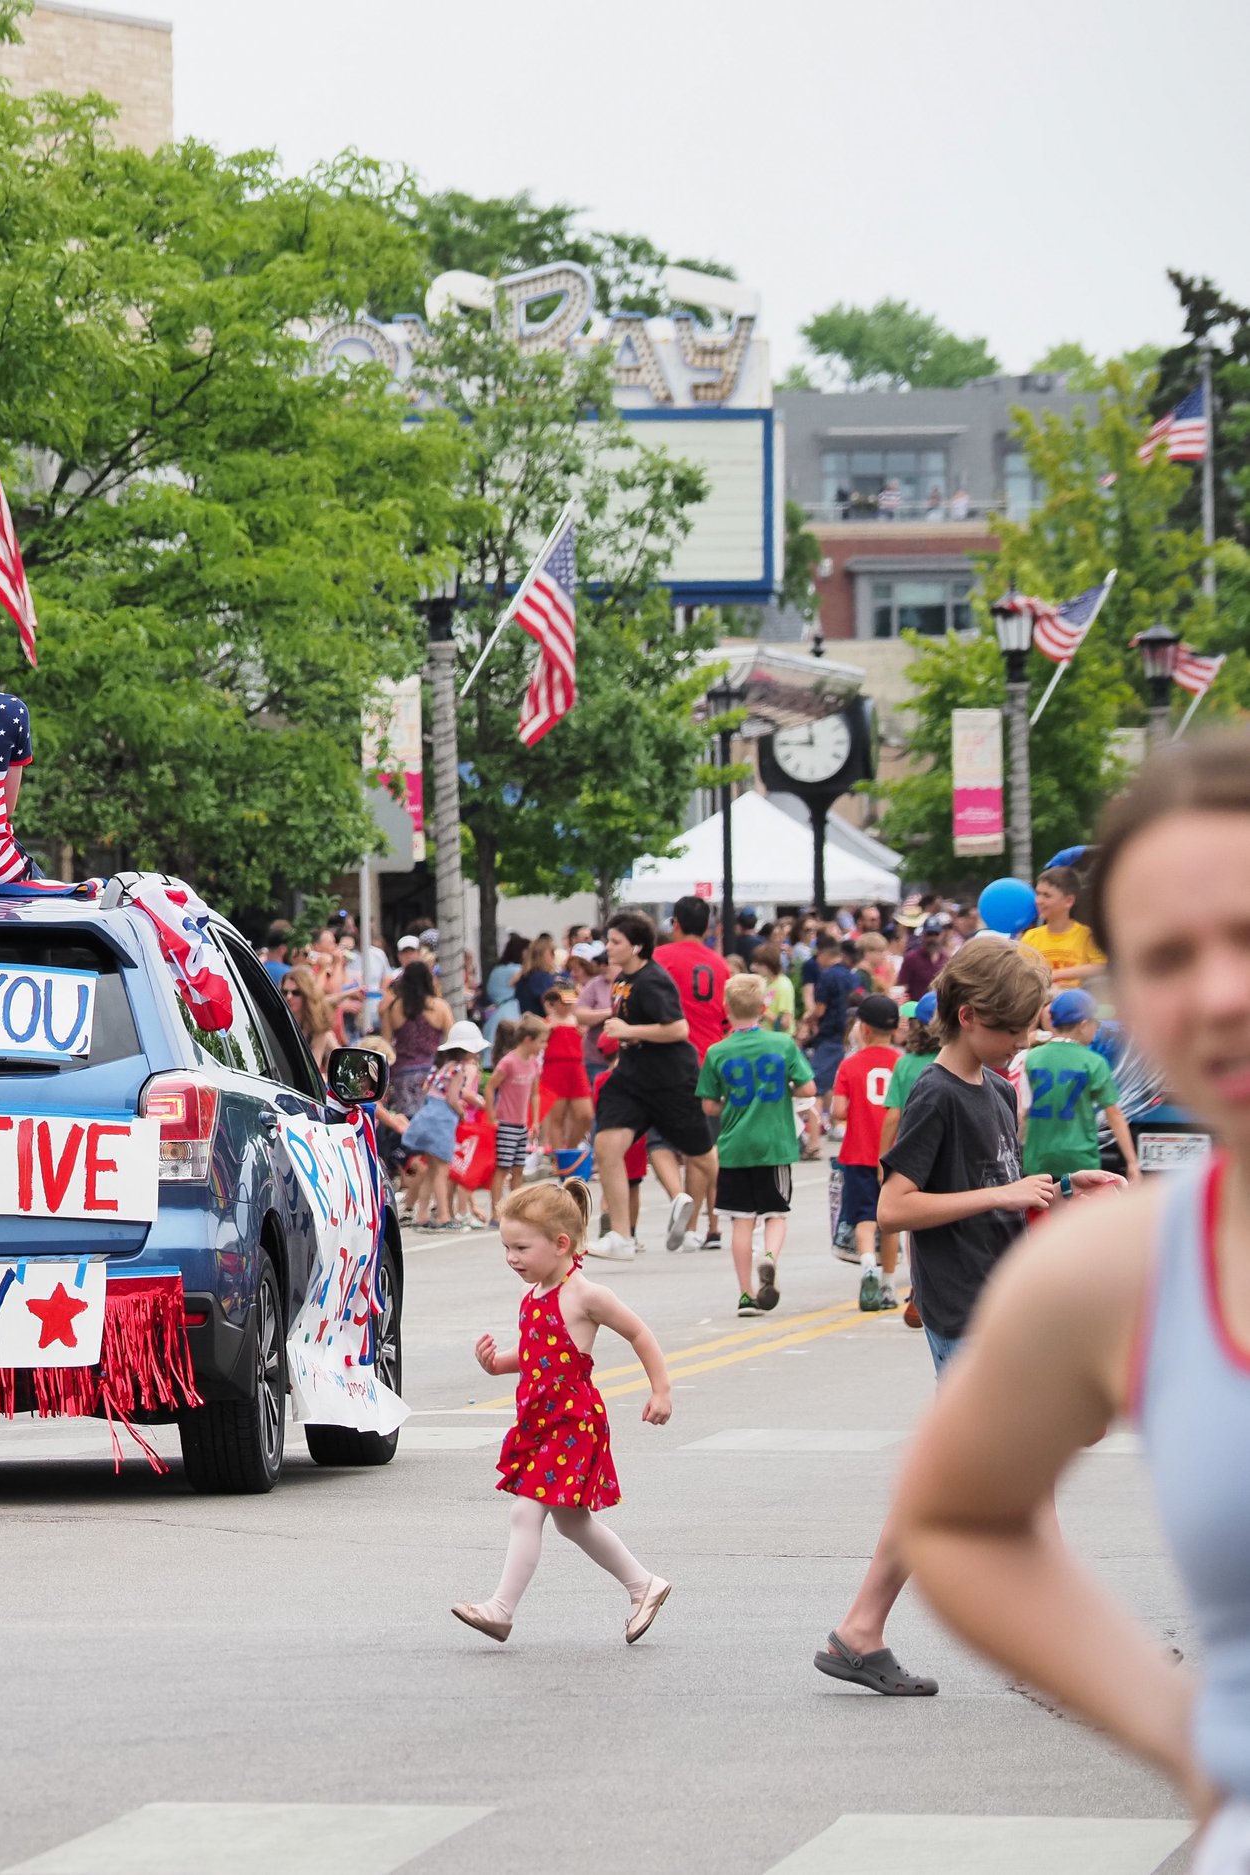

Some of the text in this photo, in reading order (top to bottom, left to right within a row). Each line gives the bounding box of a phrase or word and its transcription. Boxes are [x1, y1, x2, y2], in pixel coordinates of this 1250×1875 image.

[693, 965, 714, 1002] 0
[722, 1053, 786, 1107] 99
[1029, 1068, 1088, 1121] 27
